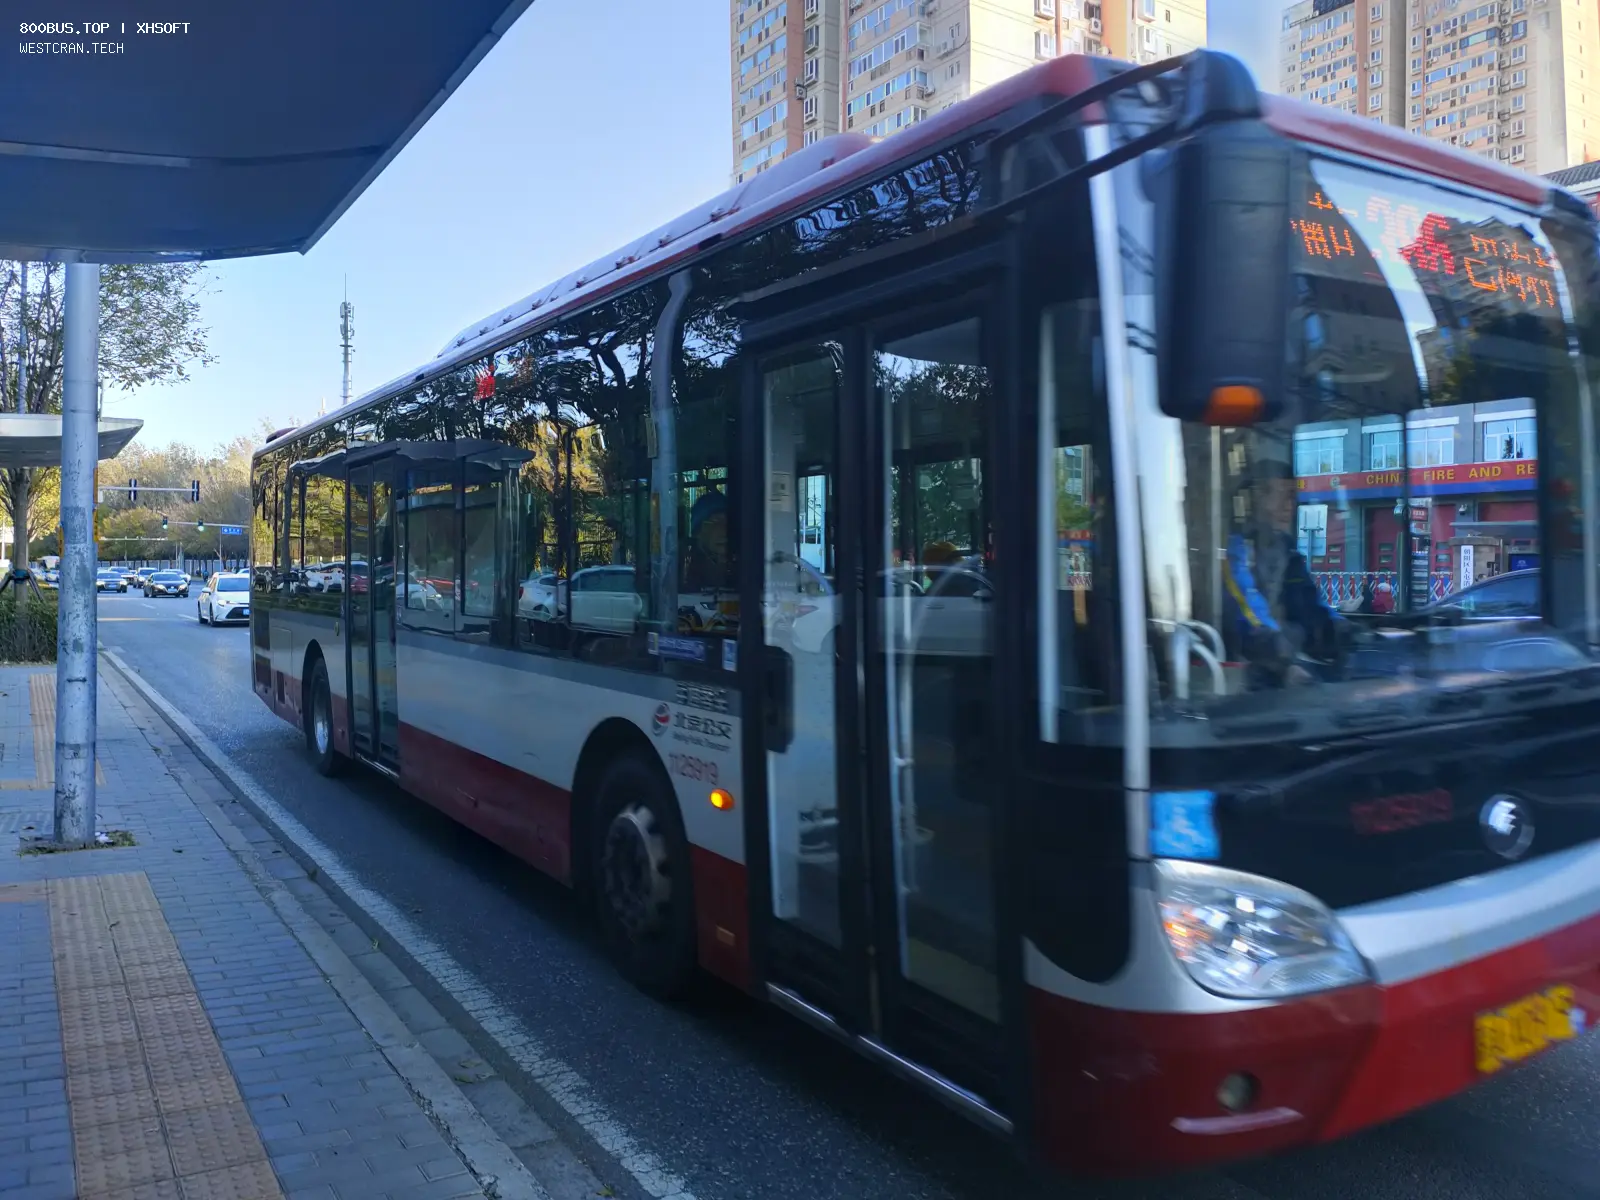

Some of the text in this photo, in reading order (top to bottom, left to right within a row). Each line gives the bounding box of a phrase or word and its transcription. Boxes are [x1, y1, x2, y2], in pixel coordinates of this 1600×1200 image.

[1366, 472, 1404, 485] CHIN
[1423, 468, 1455, 481] FIRE
[1468, 465, 1502, 479] AND
